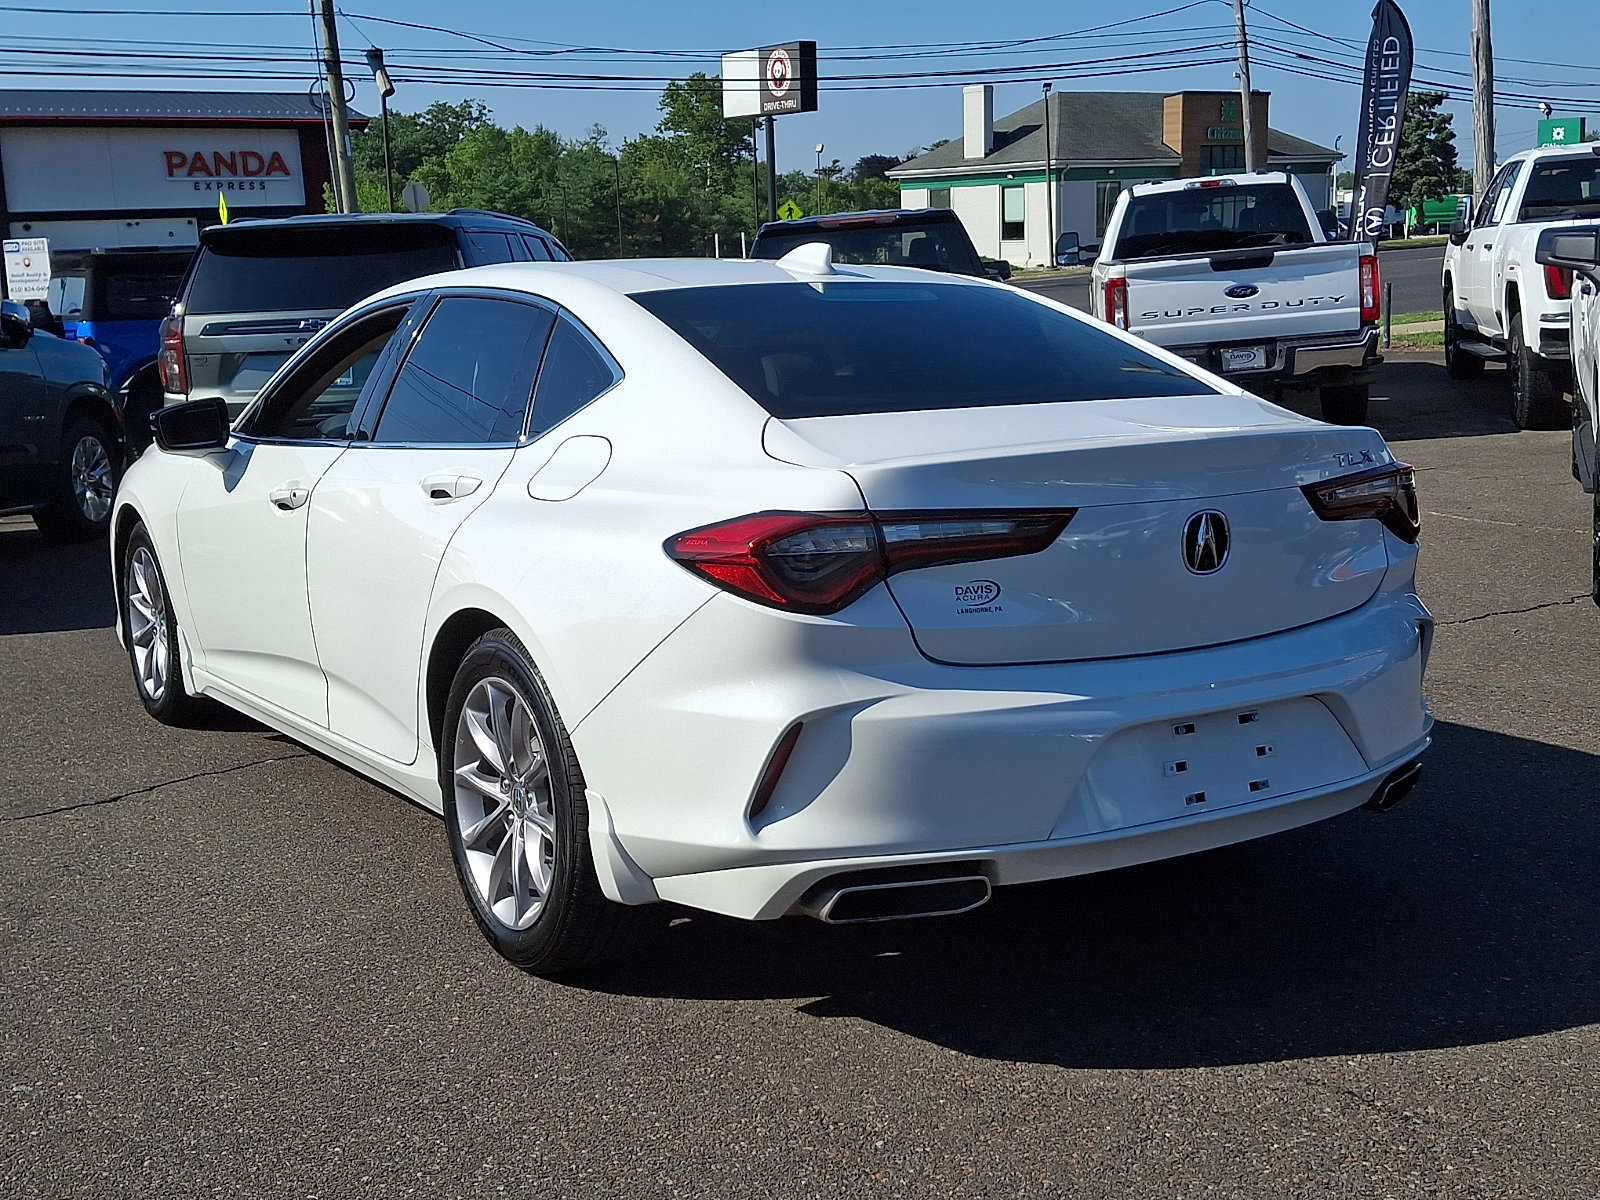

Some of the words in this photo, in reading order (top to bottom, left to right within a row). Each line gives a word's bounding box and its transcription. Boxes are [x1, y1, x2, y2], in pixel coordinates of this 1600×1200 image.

[764, 99, 796, 111] DRIVE-THRU
[163, 151, 291, 177] PANDA
[194, 181, 266, 191] EXPRESS
[1140, 303, 1251, 320] SUPER
[1261, 294, 1347, 310] DUTY
[1230, 352, 1252, 360] DAVIS
[1333, 449, 1374, 467] TLX
[955, 585, 992, 595] DAVIS
